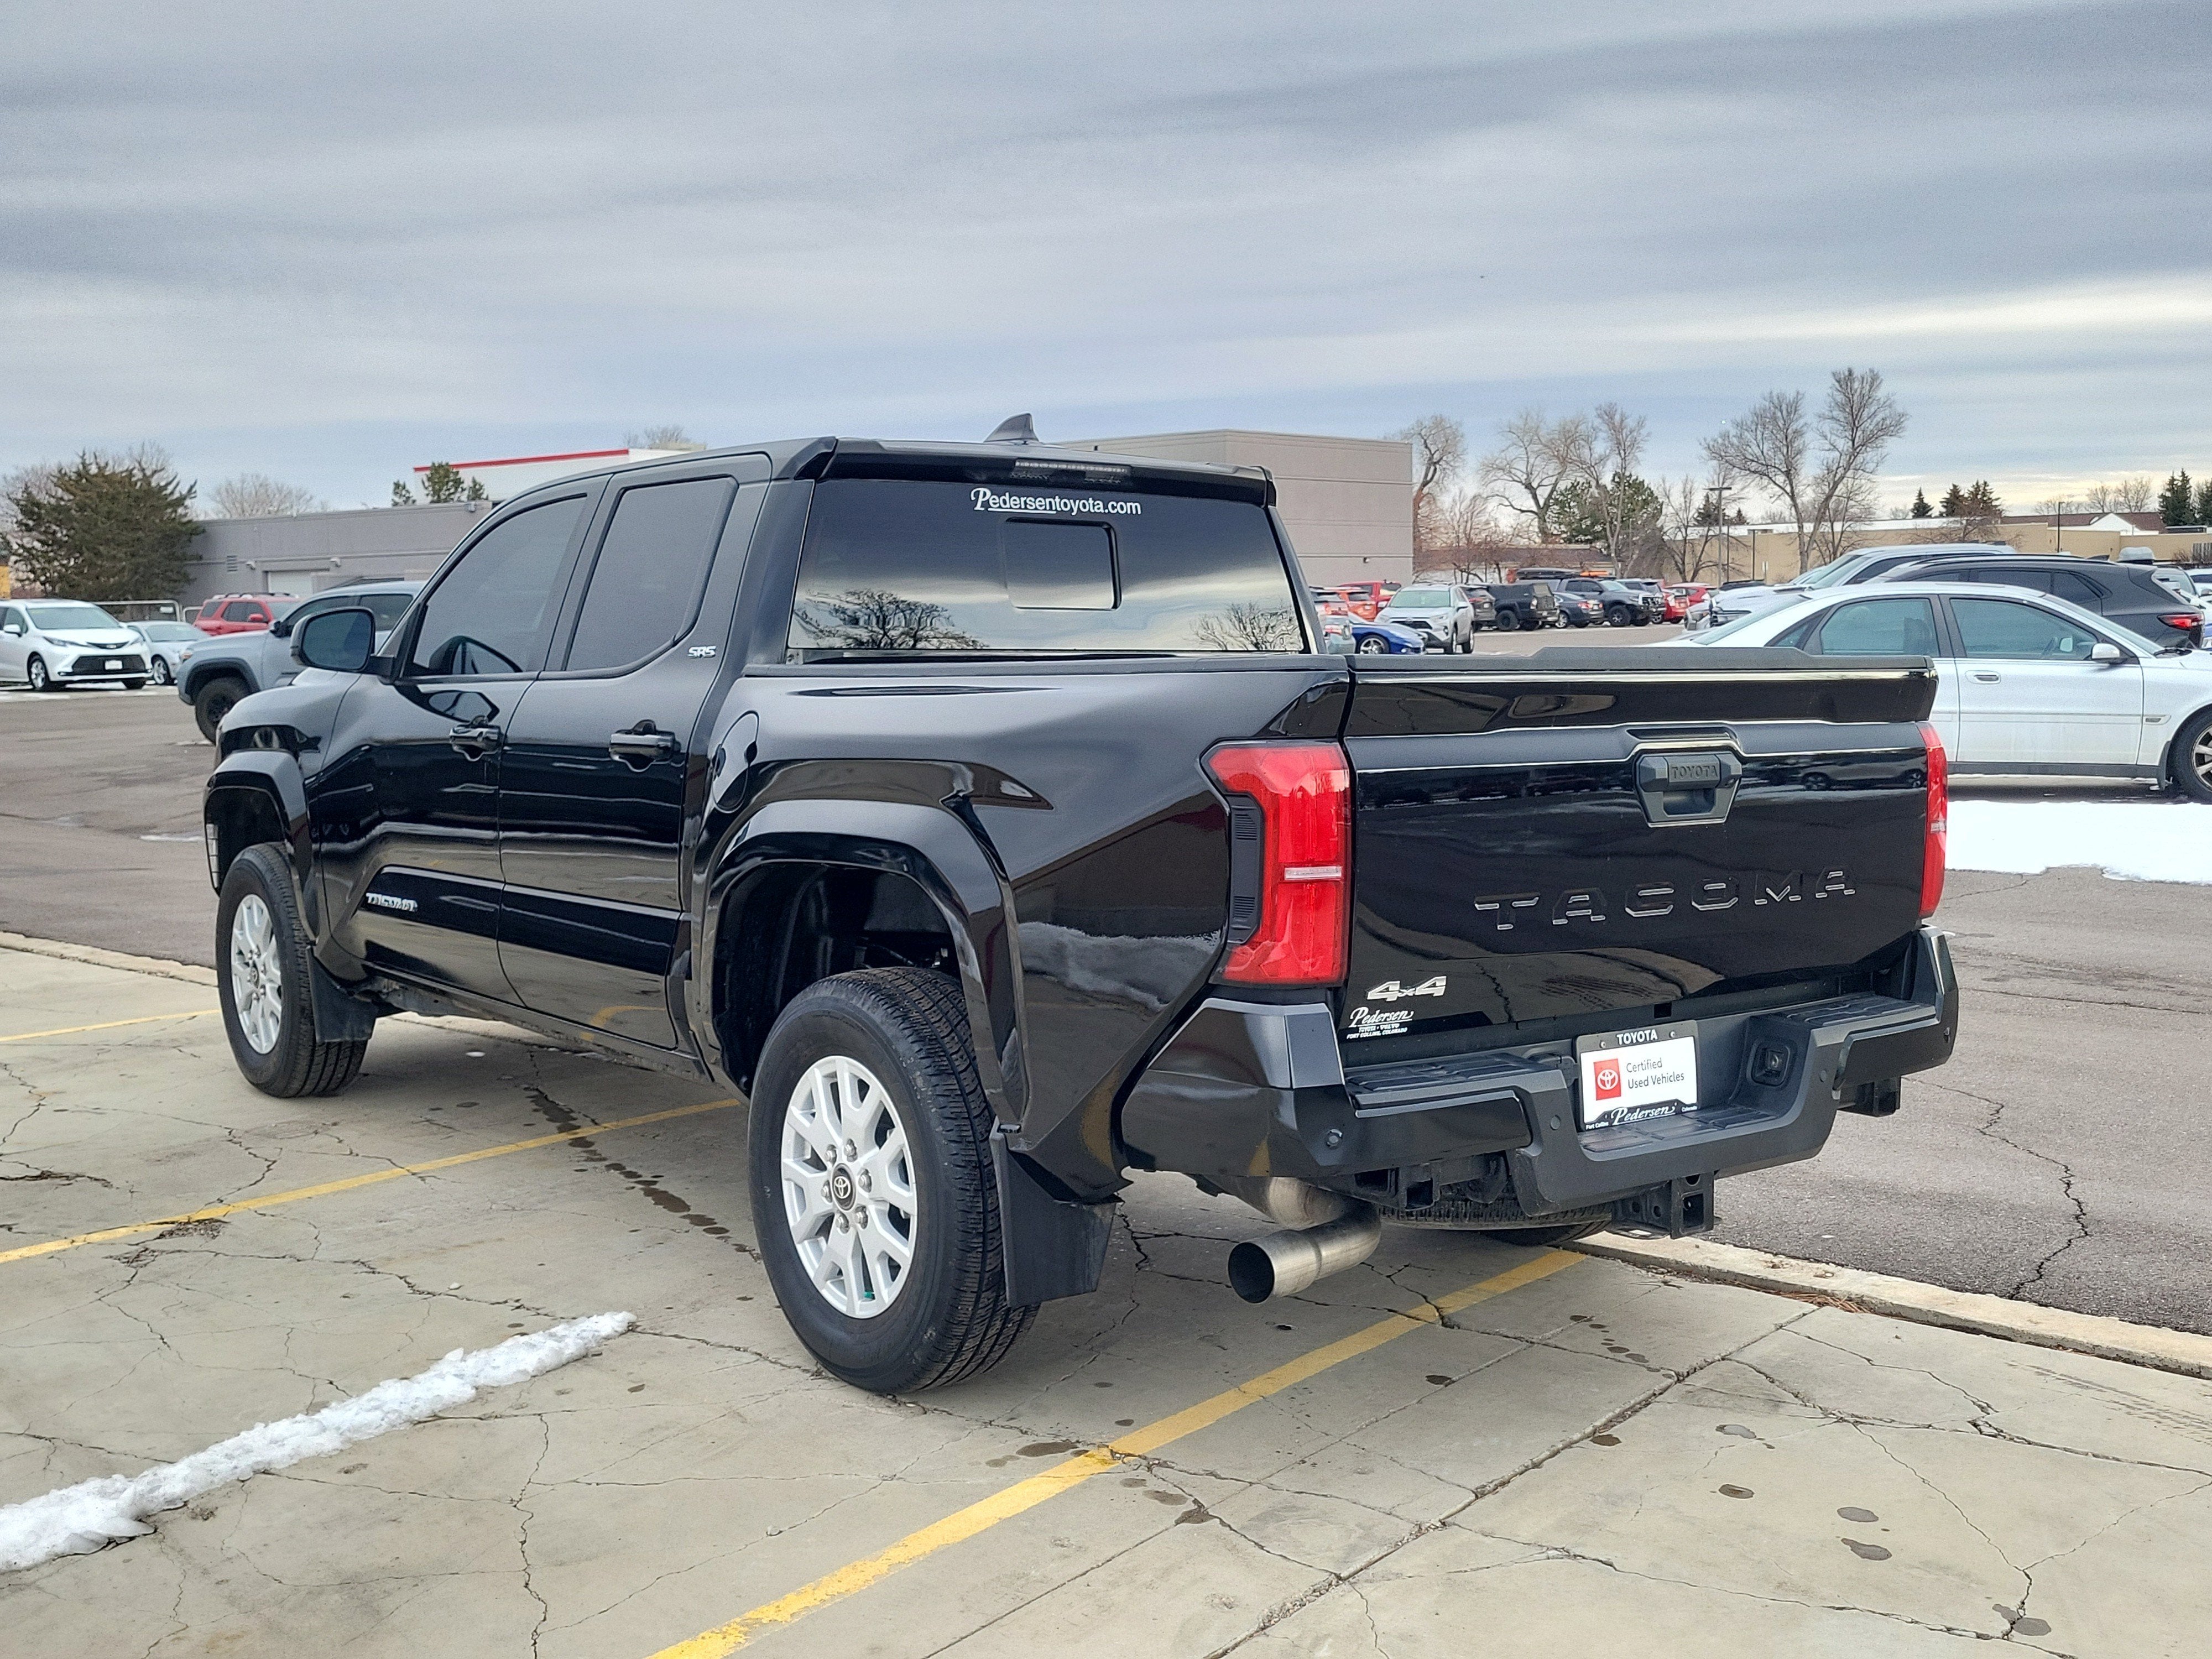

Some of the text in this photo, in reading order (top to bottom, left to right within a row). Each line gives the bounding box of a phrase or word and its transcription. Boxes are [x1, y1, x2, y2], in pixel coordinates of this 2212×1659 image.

[970, 487, 1142, 515] Pedersentoyota.com
[1670, 765, 1718, 779] TOYOTA
[1474, 864, 1856, 930] TACOMA
[1366, 975, 1447, 1001] 4x4
[1348, 1006, 1414, 1027] Pedersen
[1616, 1029, 1658, 1045] TOYOTA
[1626, 1057, 1662, 1073] Certified
[1627, 1072, 1684, 1089] Used Vehicles
[1610, 1106, 1676, 1125] Pedersen
